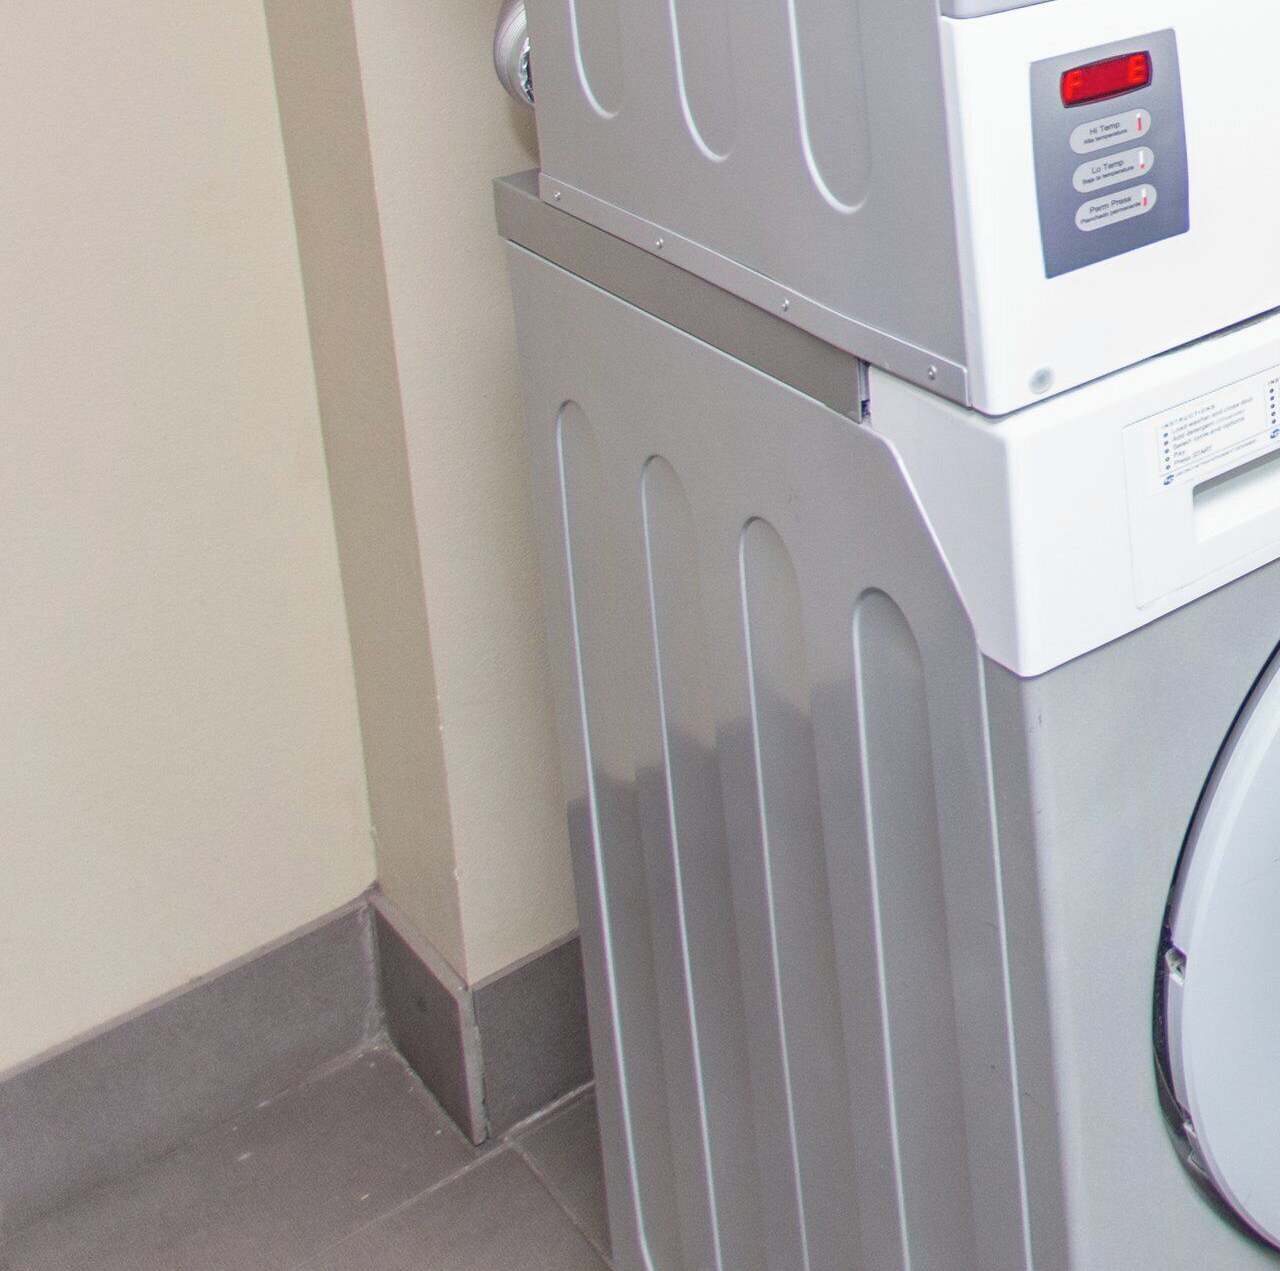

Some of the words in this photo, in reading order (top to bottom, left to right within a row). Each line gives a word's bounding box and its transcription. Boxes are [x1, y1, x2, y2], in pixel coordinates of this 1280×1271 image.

[1100, 121, 1121, 133] Temp
[1091, 166, 1102, 175] Lo
[1103, 159, 1124, 171] Temp
[1089, 203, 1110, 214] Perm
